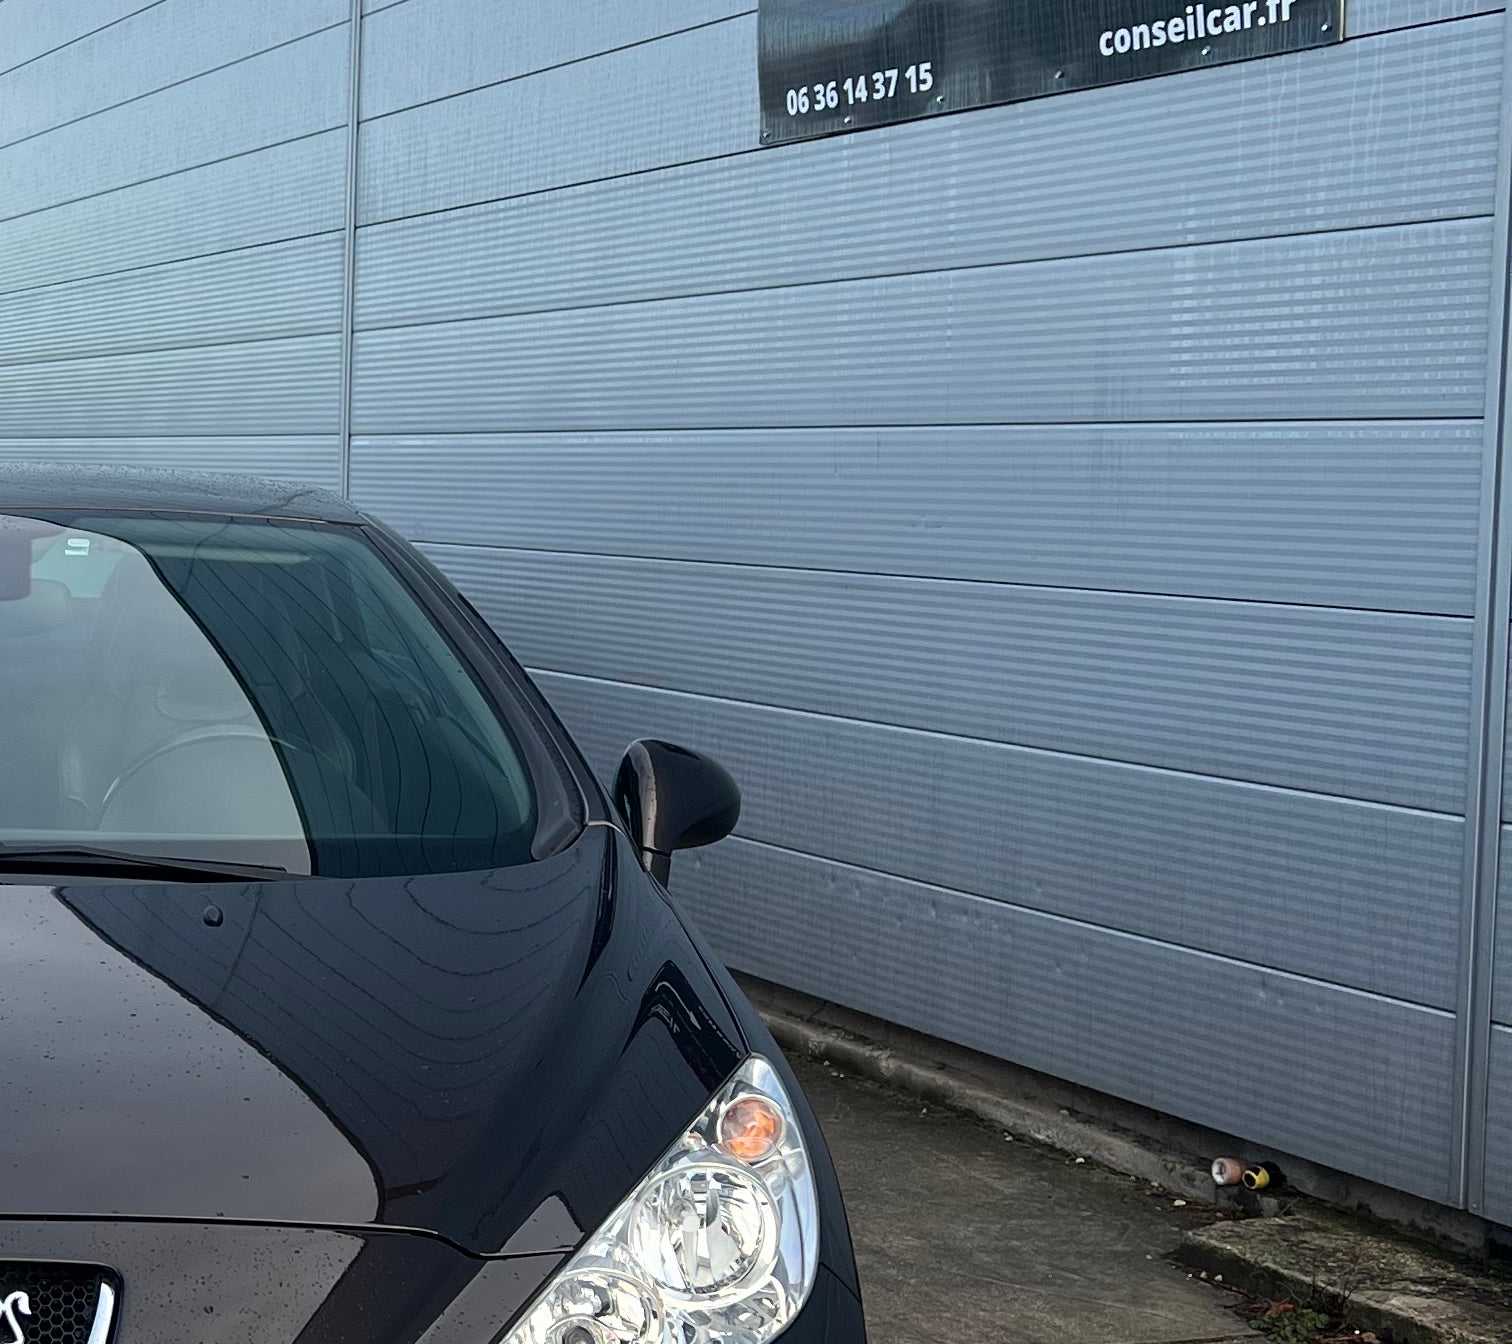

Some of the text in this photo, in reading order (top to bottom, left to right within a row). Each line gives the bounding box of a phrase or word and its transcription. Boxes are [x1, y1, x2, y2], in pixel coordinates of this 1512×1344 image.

[786, 61, 934, 116] 06 36 14 37 15
